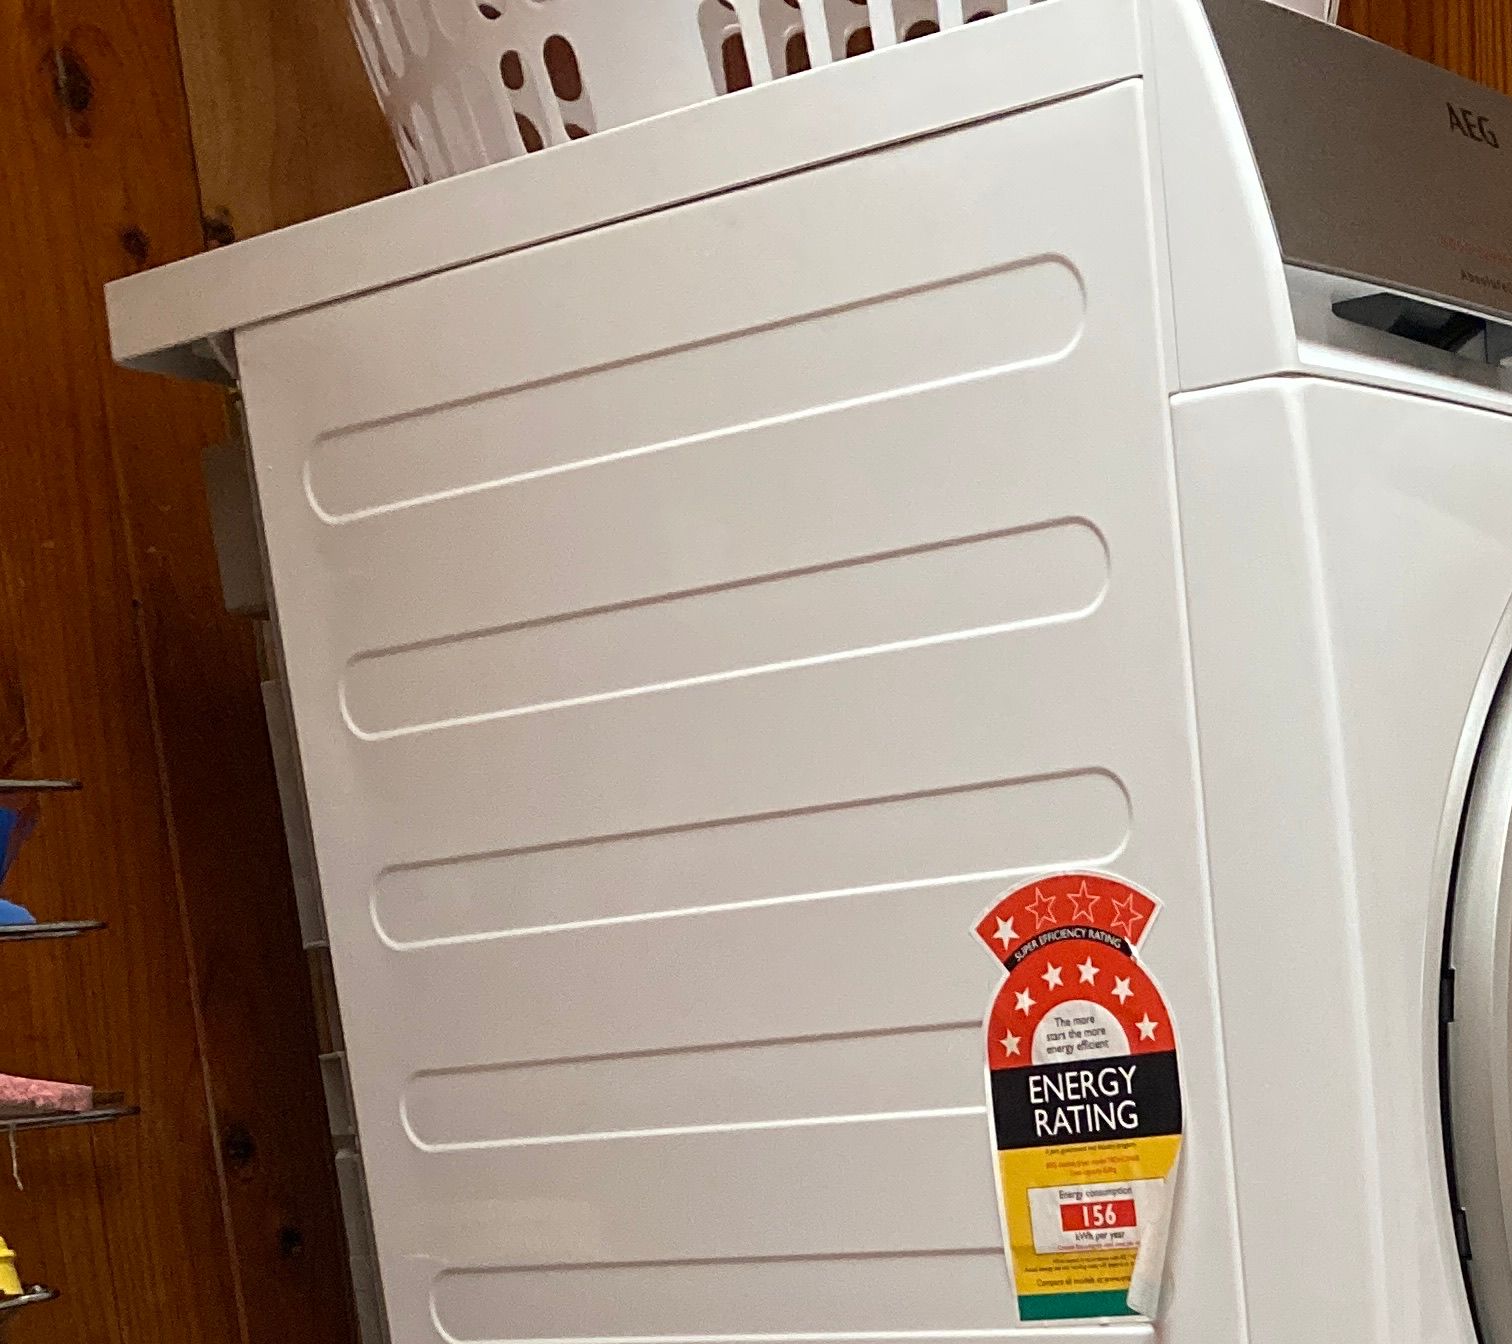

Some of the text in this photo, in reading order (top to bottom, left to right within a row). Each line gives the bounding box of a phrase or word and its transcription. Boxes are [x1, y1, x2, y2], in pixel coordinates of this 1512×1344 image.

[1446, 102, 1500, 149] AEG
[1014, 927, 1122, 962] SUPER EFFICIENCY RATING
[1054, 1016, 1095, 1027] The more
[1046, 1027, 1106, 1042] stars the more
[1046, 1039, 1110, 1055] energy efficient
[1028, 1065, 1137, 1104] ENERGY
[1034, 1100, 1139, 1137] RATING
[1059, 1187, 1133, 1200] Energy consumption
[1082, 1203, 1117, 1227] 156
[1075, 1231, 1126, 1242] kWh per year
